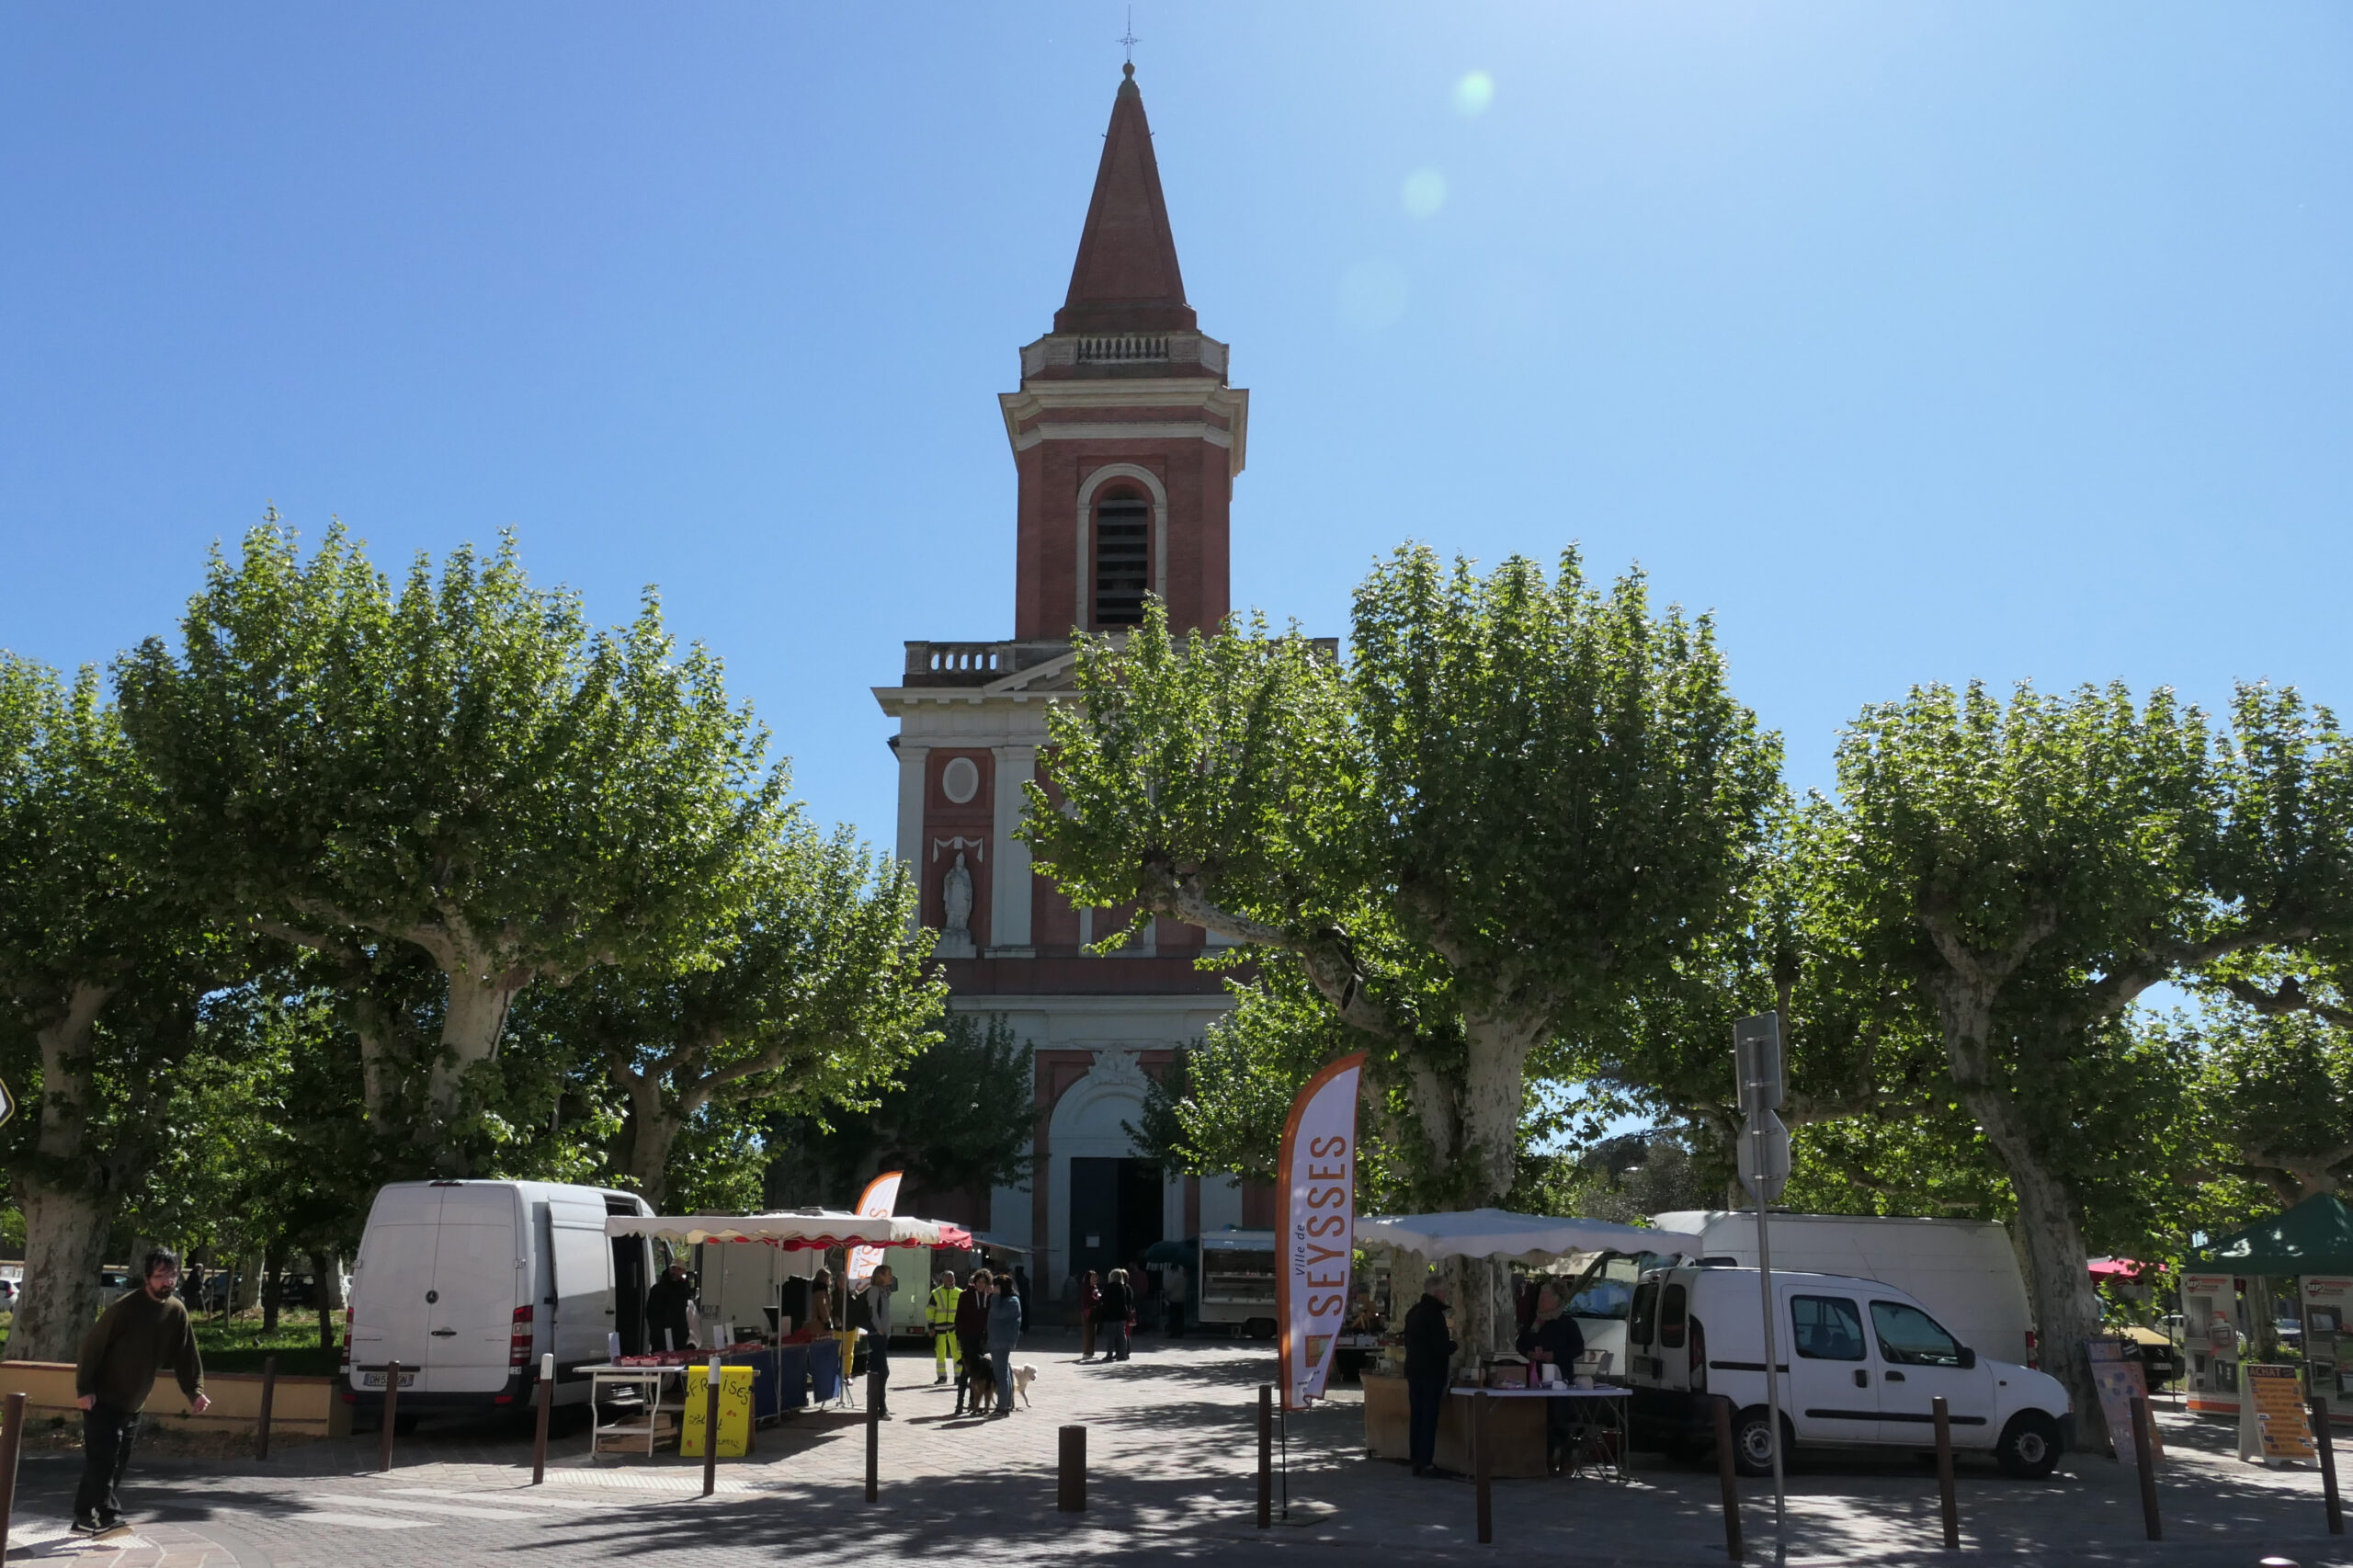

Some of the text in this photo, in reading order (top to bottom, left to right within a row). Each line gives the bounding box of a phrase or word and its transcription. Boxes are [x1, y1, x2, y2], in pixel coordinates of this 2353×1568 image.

[1295, 1224, 1305, 1276] Ville de
[1306, 1136, 1347, 1317] SEYSSES
[2249, 1367, 2281, 1377] ACHAT
